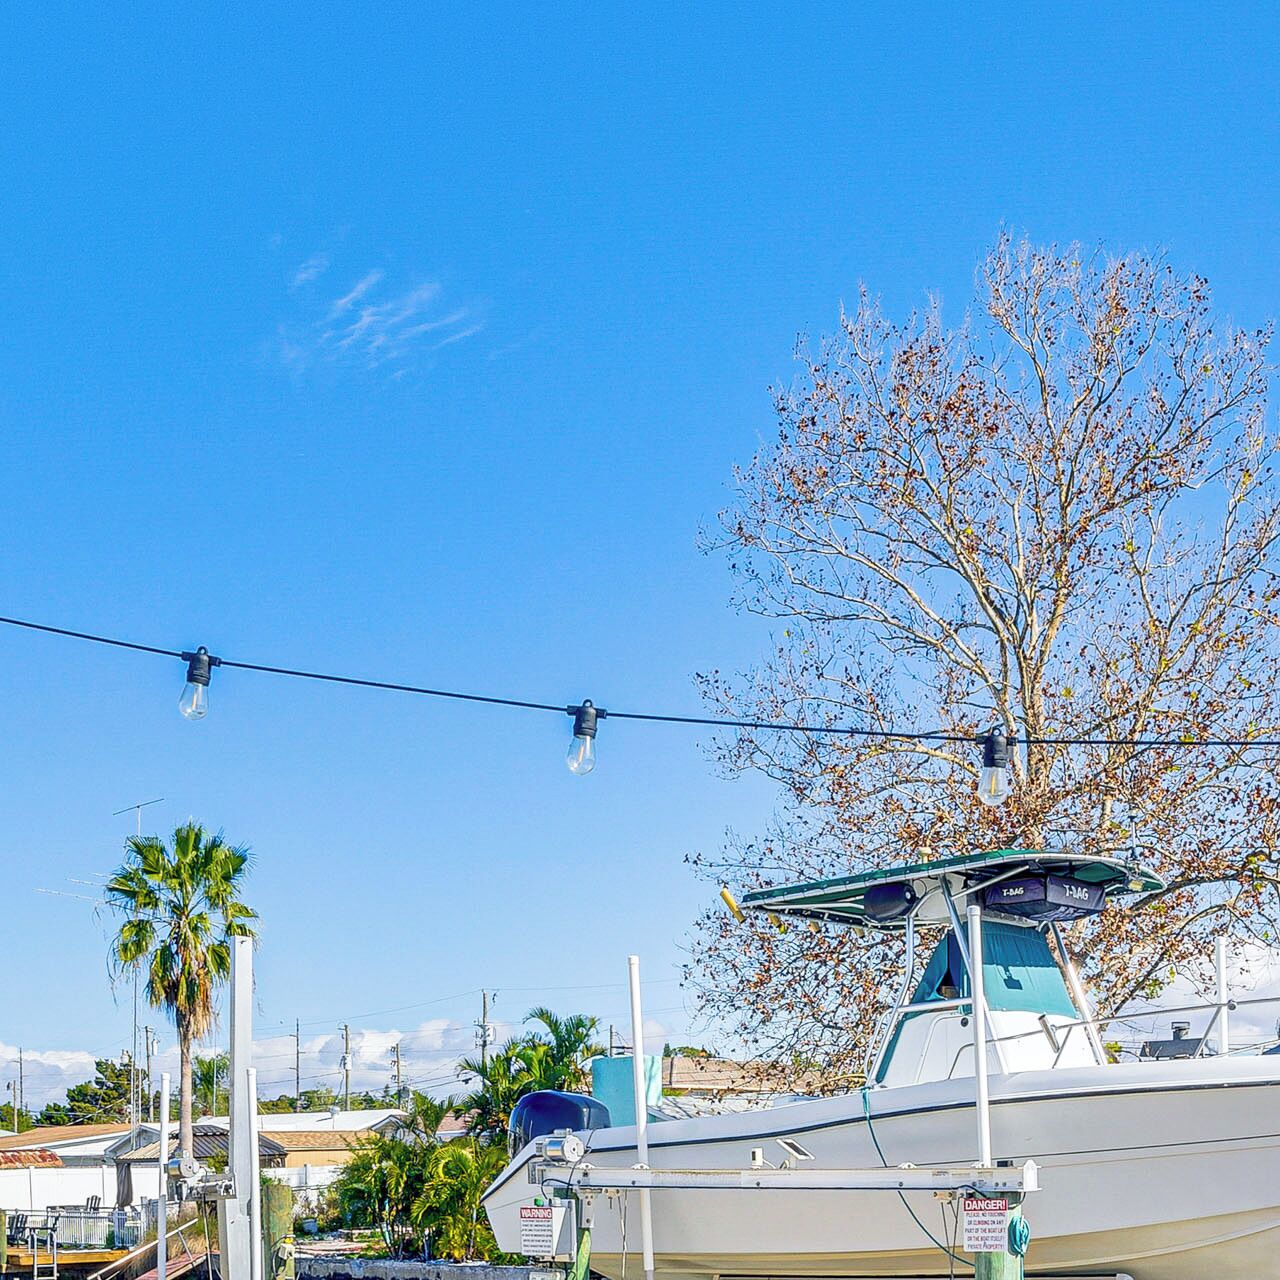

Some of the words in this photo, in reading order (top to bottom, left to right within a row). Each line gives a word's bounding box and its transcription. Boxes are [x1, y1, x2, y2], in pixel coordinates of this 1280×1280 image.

[1002, 887, 1024, 897] T-BAG
[1063, 884, 1089, 900] T-BAG
[965, 1200, 1006, 1210] DANGER!
[521, 1209, 551, 1218] WARNING
